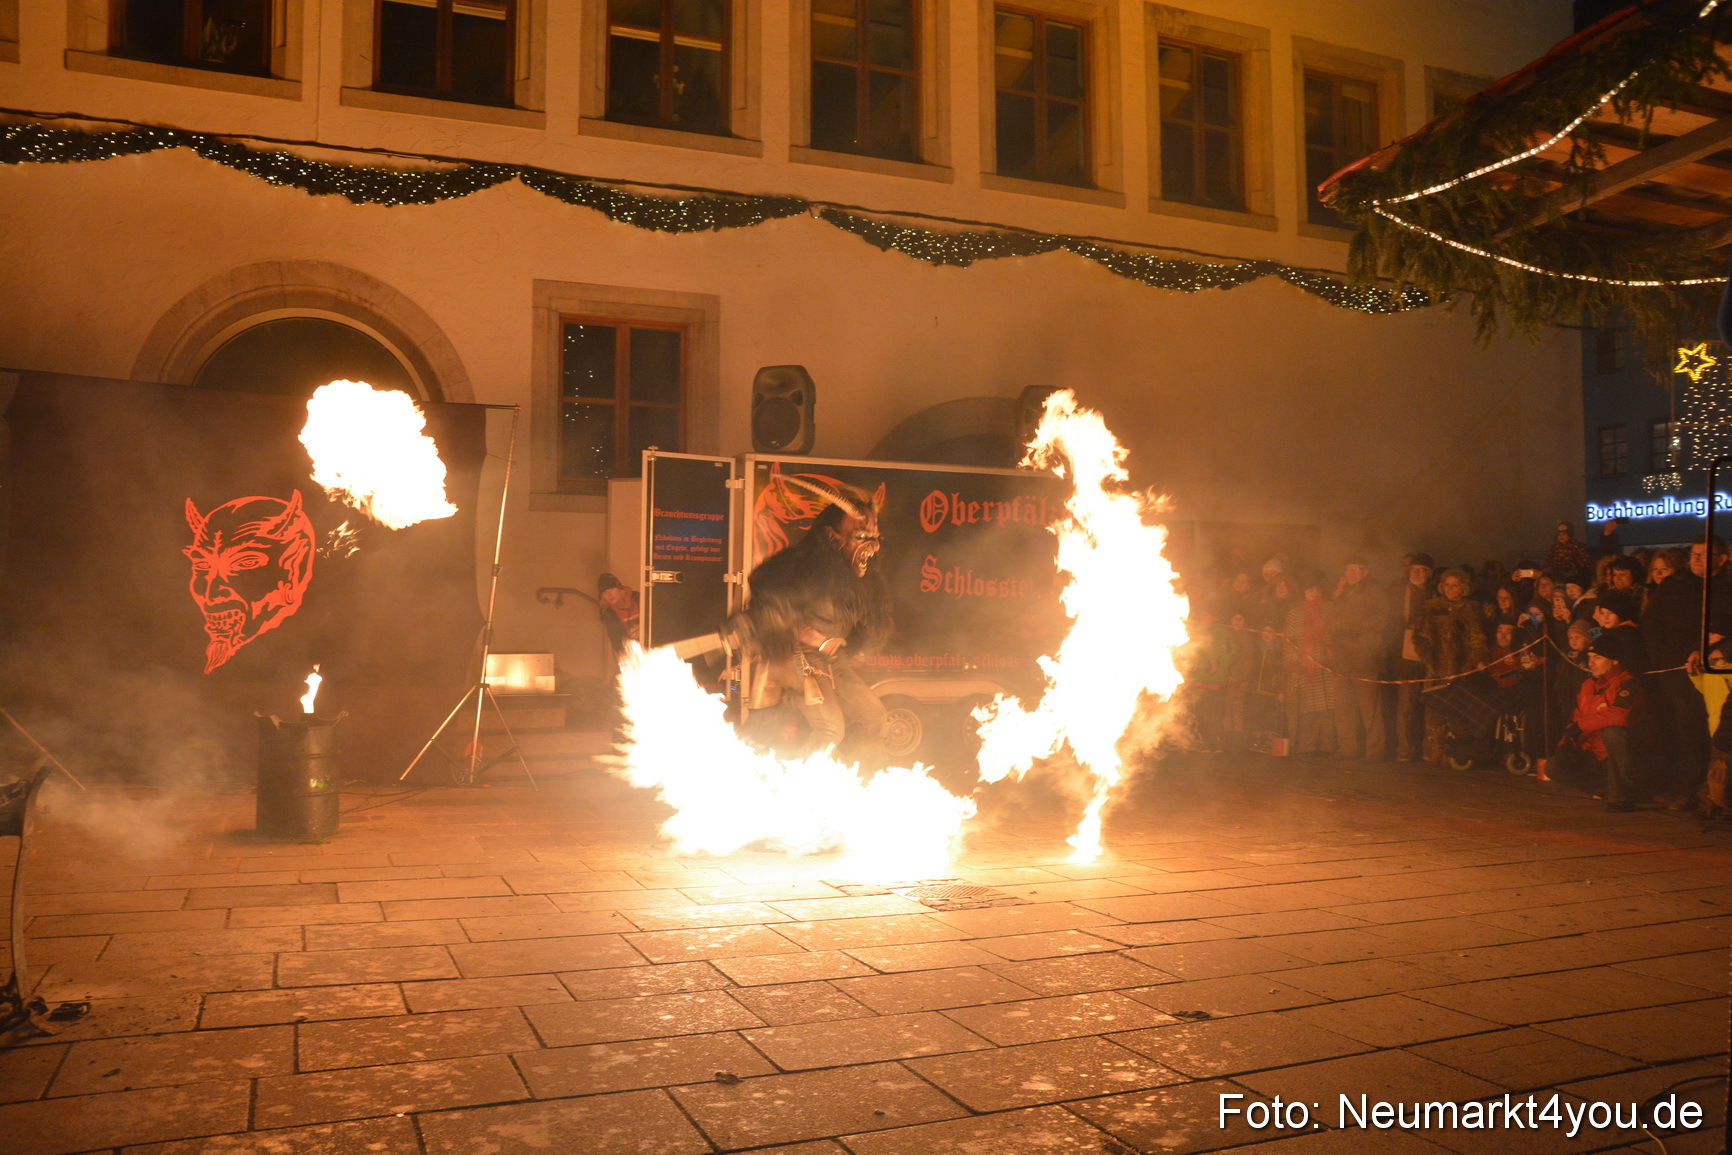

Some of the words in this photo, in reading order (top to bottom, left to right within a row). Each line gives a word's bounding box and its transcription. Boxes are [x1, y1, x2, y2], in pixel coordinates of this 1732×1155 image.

[1586, 496, 1707, 521] Buchhandlung
[1713, 492, 1732, 511] Ru
[919, 554, 1034, 600] Schlosste
